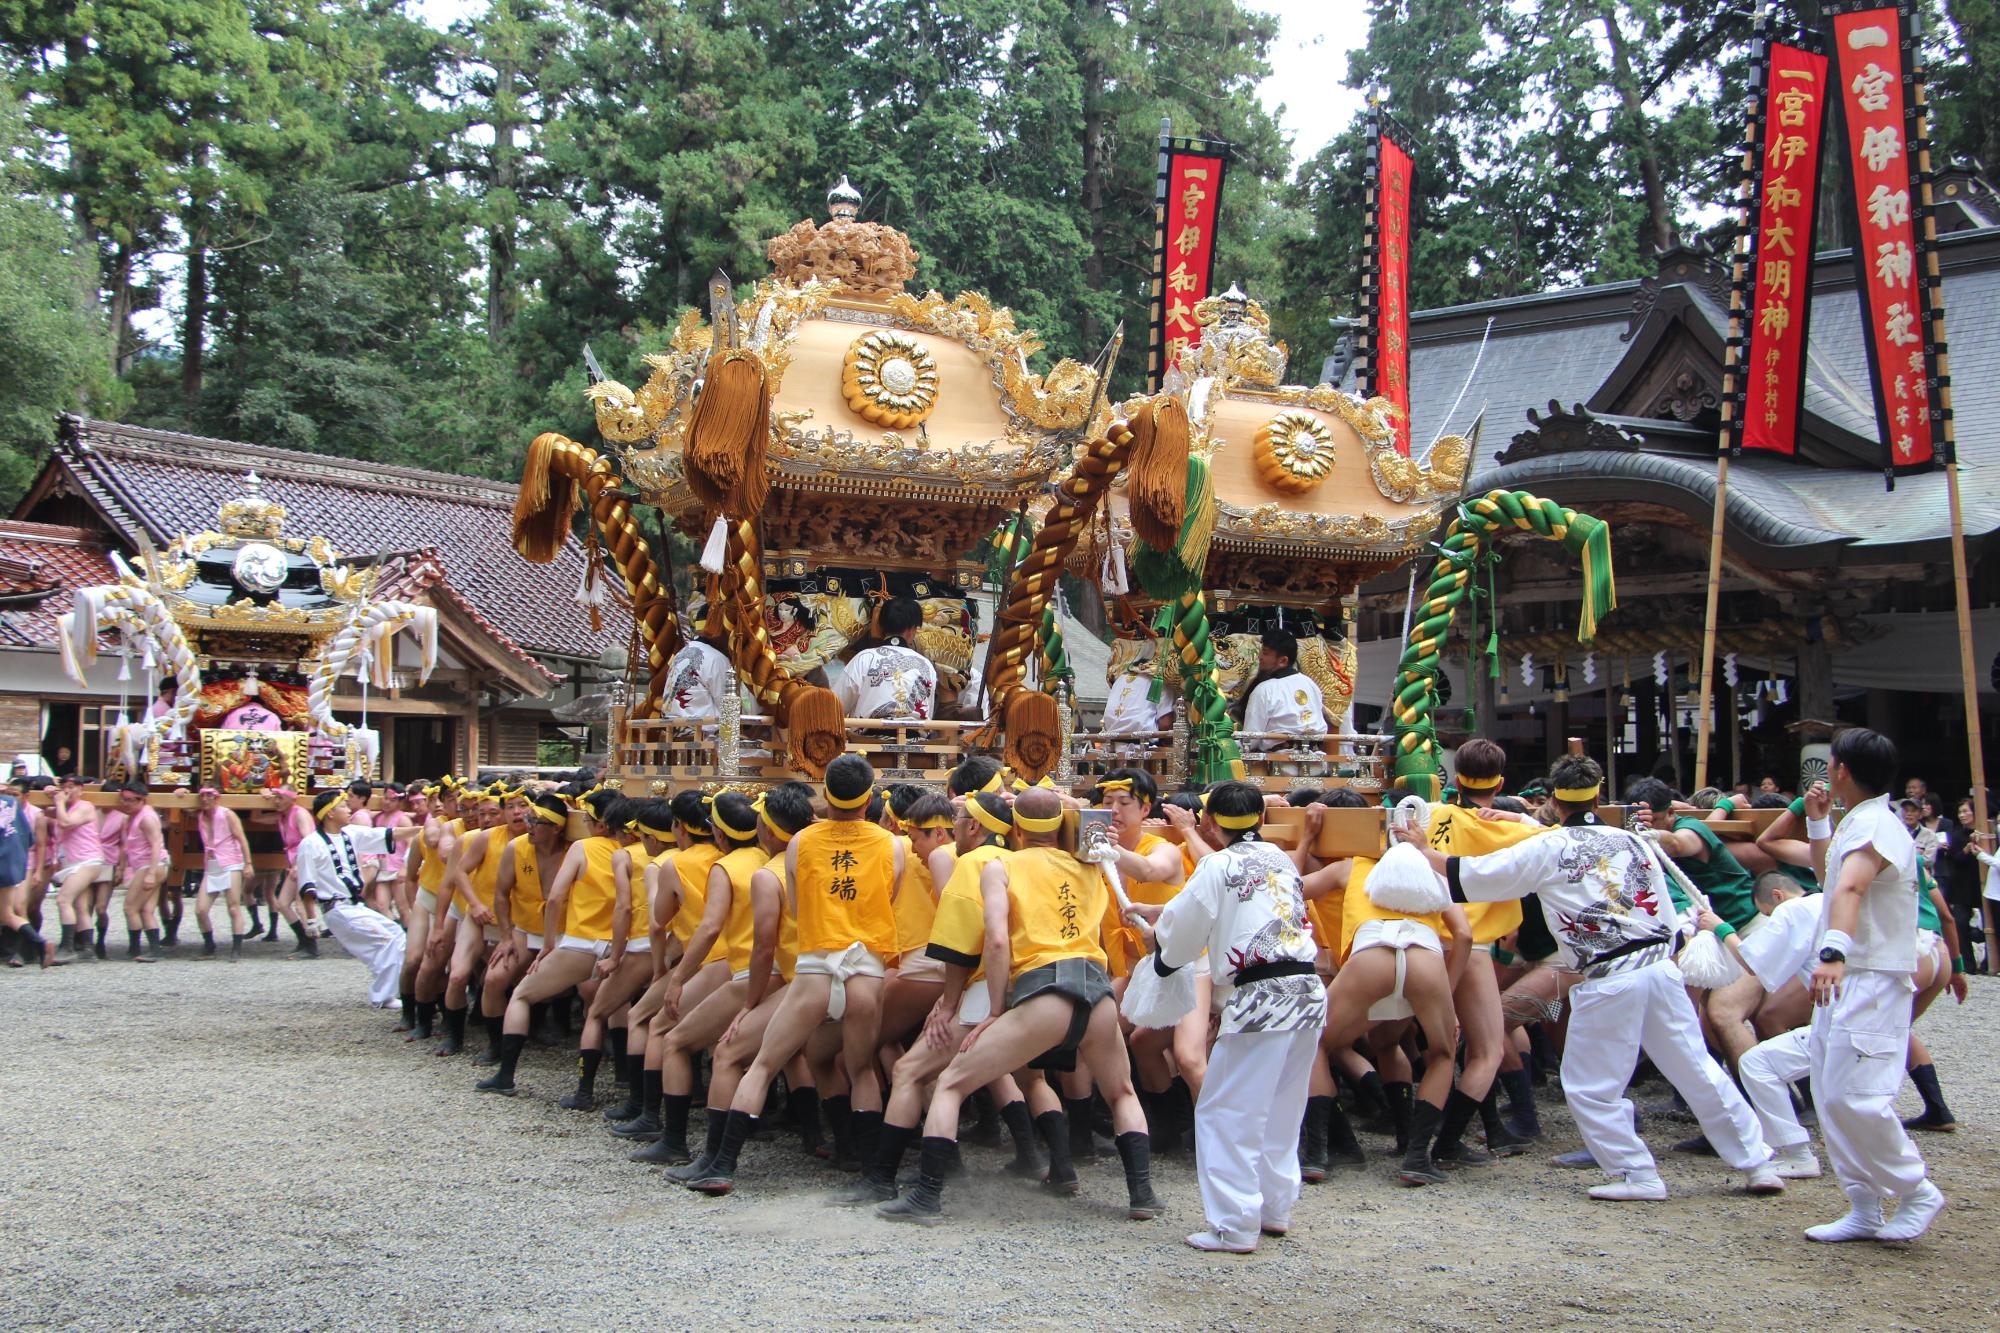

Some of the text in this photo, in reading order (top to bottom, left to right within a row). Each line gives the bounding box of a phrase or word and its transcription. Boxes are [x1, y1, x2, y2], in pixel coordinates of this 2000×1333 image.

[1760, 69, 1815, 341] 一宮伊和大明神
[1848, 26, 1919, 347] 一宮伊和神社
[1765, 347, 1780, 429] 伊和村中
[830, 849, 859, 901] 棒端
